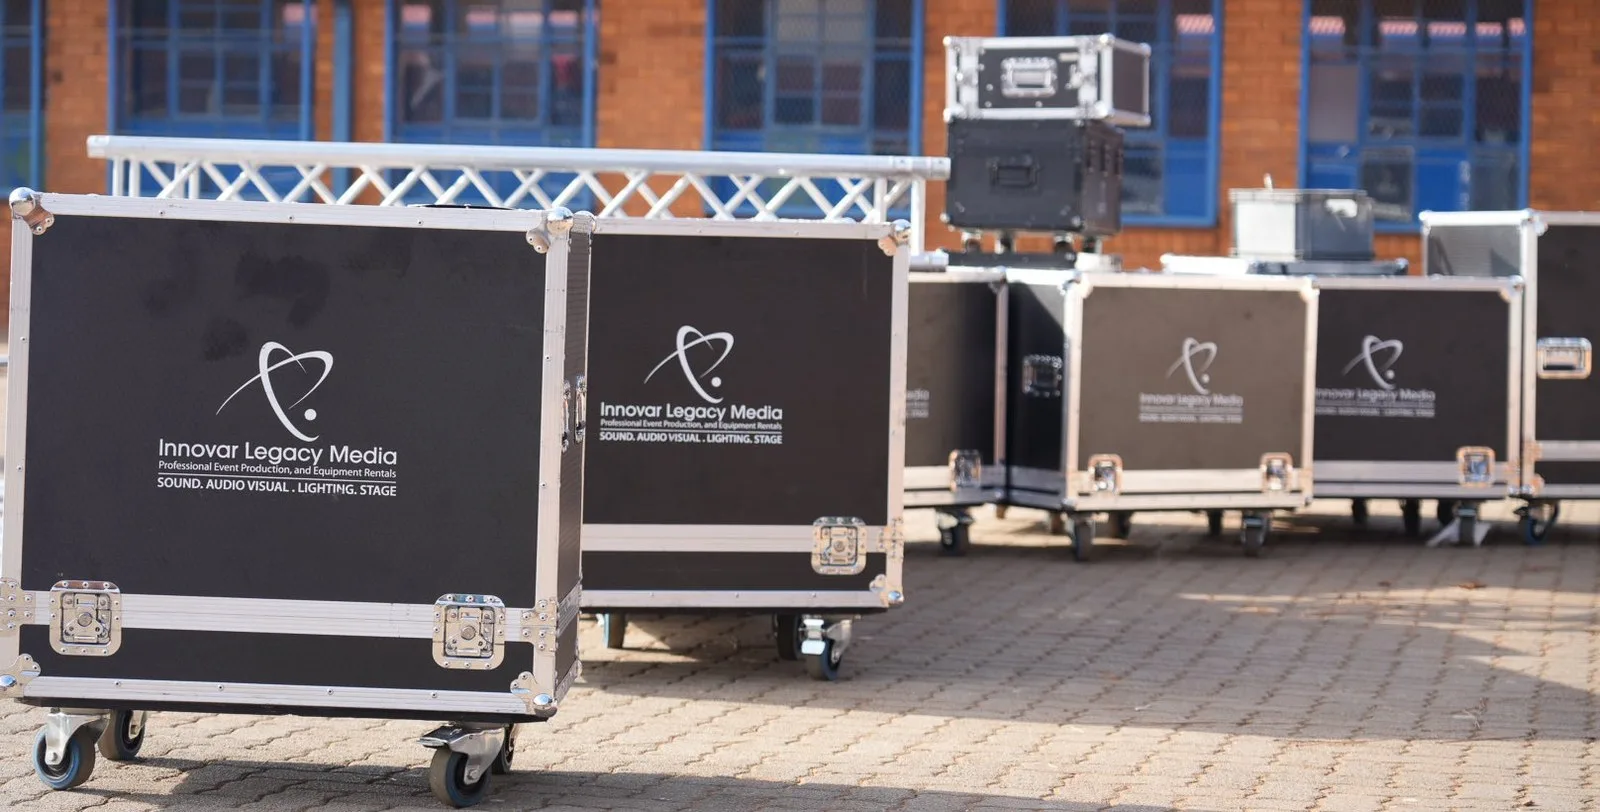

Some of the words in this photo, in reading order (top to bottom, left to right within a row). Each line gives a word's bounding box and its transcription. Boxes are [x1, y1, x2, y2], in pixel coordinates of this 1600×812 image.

[600, 401, 662, 417] Innovar
[666, 403, 726, 422] Legacy
[731, 404, 783, 420] Media
[600, 418, 642, 427] Professional
[643, 420, 662, 428] Event
[664, 420, 702, 429] Production,
[704, 421, 717, 429] and
[719, 421, 756, 431] Equipment
[757, 422, 782, 430] Rentals
[599, 431, 636, 441] SOUND.
[637, 432, 668, 442] AUDIO
[668, 433, 700, 443] VISUAL
[707, 434, 753, 444] LIGHTING.
[754, 435, 783, 444] STAGE
[159, 438, 238, 459] Innovar
[245, 441, 323, 466] Legacy
[329, 445, 397, 465] Media
[158, 460, 212, 471] Professional
[214, 462, 238, 472] Event
[241, 463, 292, 475] Production,
[294, 465, 311, 475] and
[314, 466, 361, 478] Equipment
[364, 468, 396, 478] Rentals
[157, 477, 203, 490] SOUND.
[206, 478, 246, 491] AUDIO
[248, 480, 290, 493] VISUAL
[297, 482, 357, 496] LIGHTING.
[359, 484, 397, 496] STAGE
